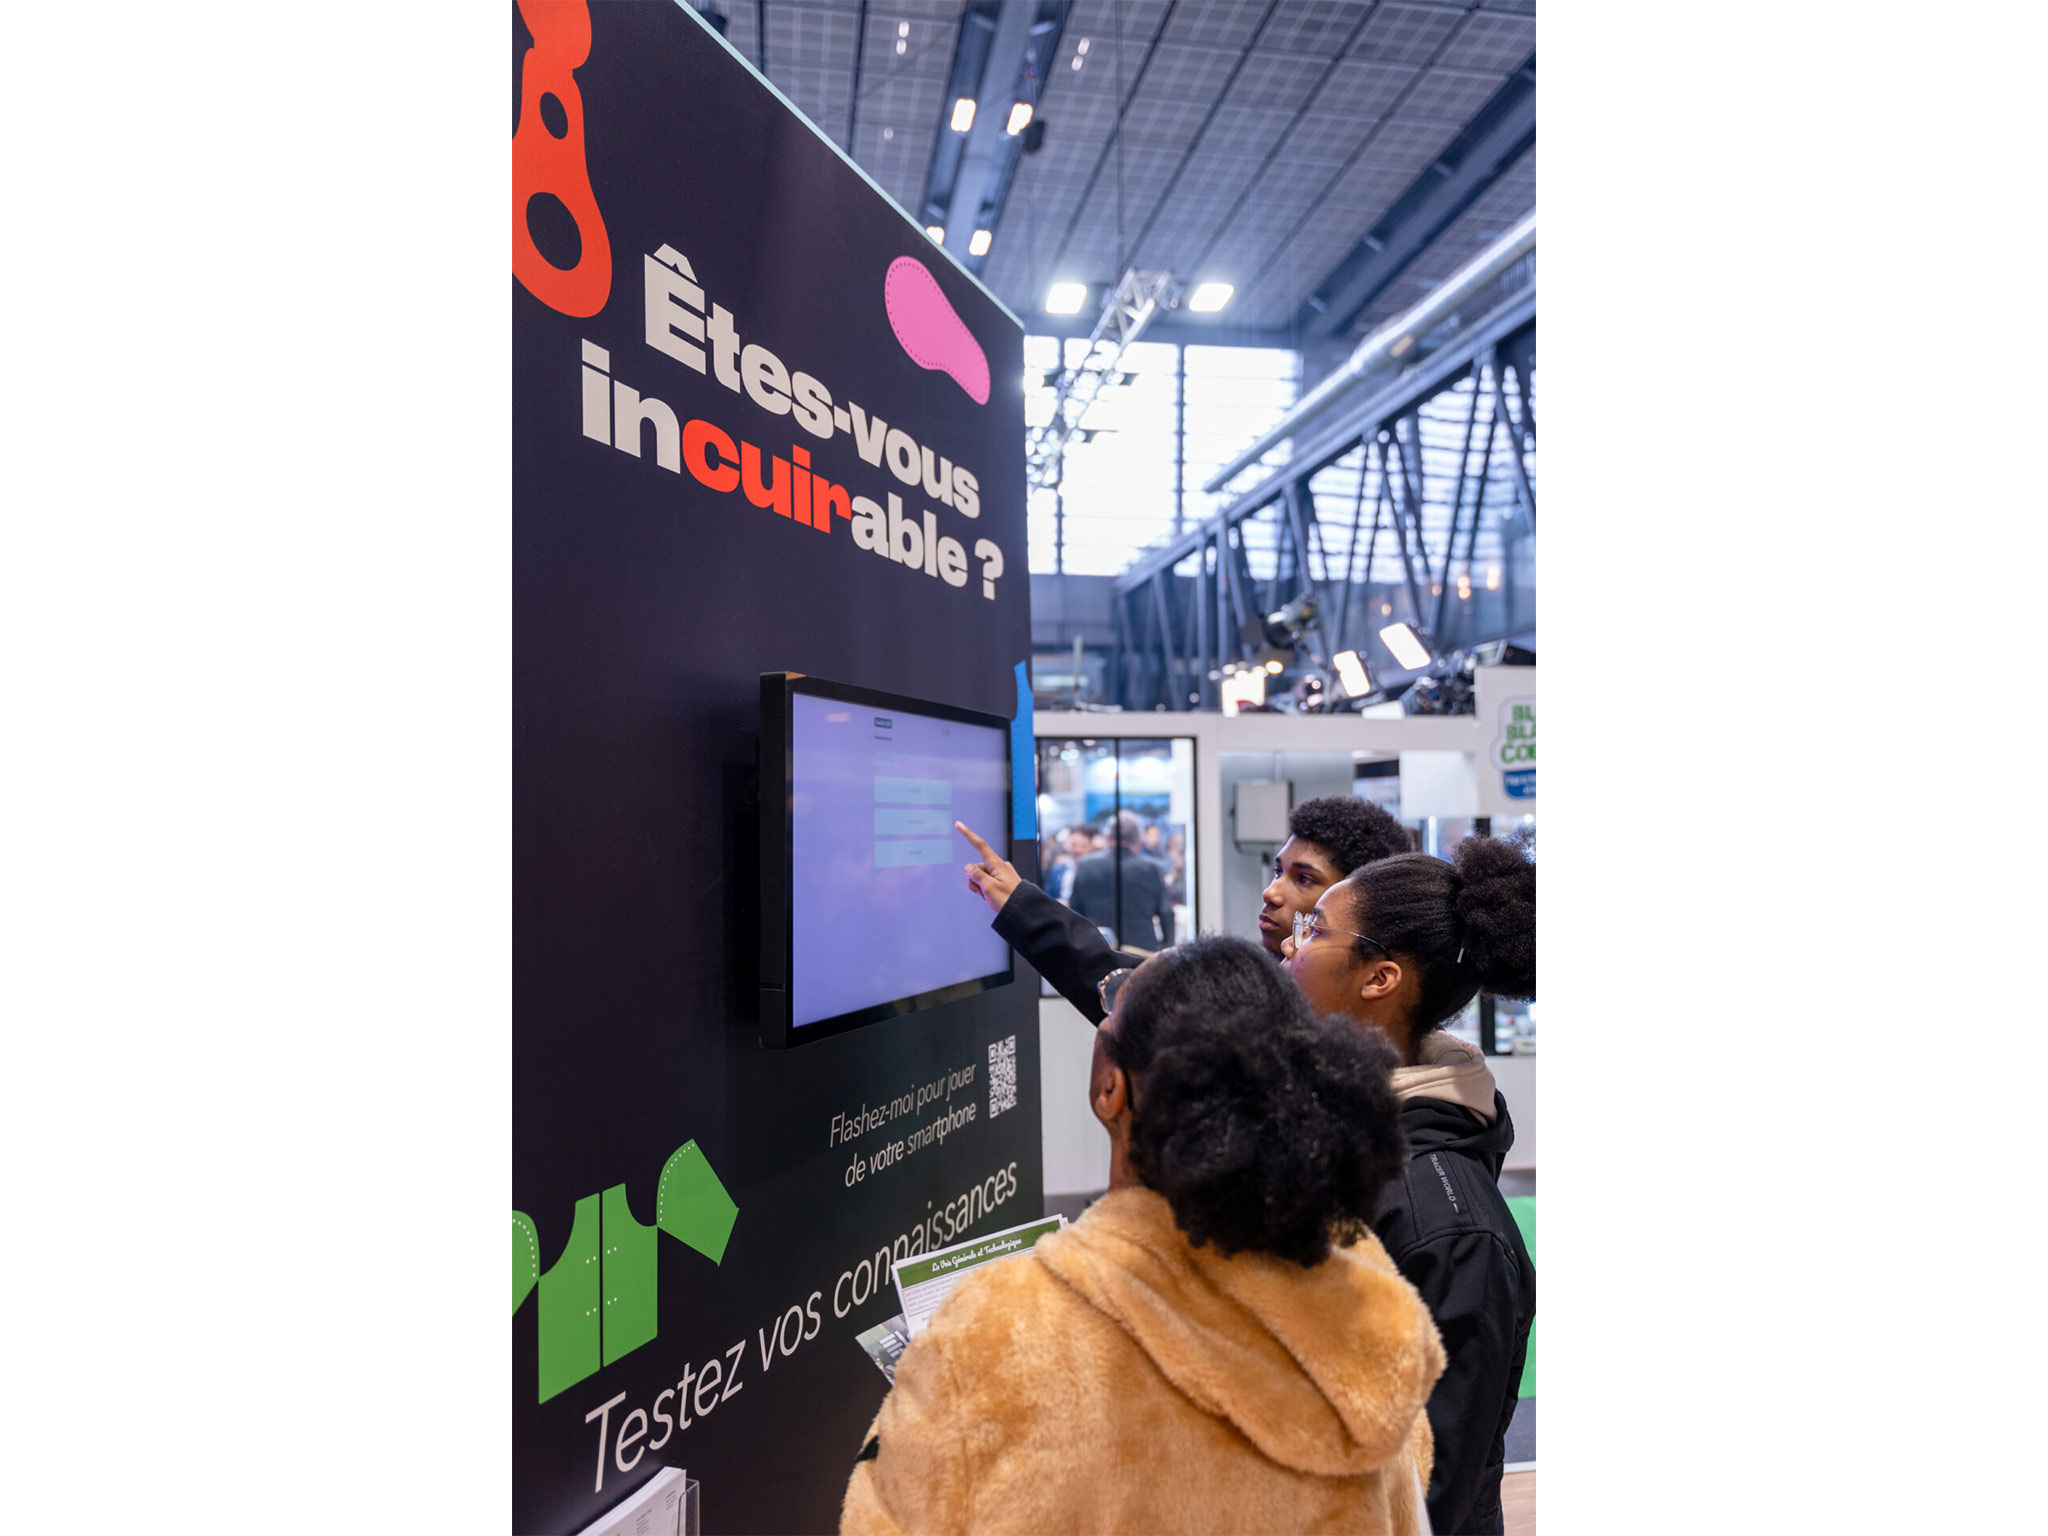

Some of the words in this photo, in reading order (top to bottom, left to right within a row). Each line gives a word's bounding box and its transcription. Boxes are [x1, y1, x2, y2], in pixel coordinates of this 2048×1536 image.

[644, 243, 981, 518] Êtes-vous
[582, 338, 968, 588] incuirable
[975, 538, 1004, 600] ?
[830, 1084, 915, 1148] Flashez-moi
[916, 1077, 946, 1116] pour
[946, 1063, 976, 1101] jouer
[845, 1152, 866, 1188] de
[870, 1140, 904, 1175] votre
[907, 1102, 977, 1155] smartphone
[1429, 1154, 1446, 1176] TRACER
[1441, 1176, 1457, 1202] WORLD
[984, 1238, 1022, 1255] Technologique
[585, 1339, 746, 1493] Testez
[758, 1291, 822, 1371] vos
[833, 1161, 1018, 1320] connaissances
